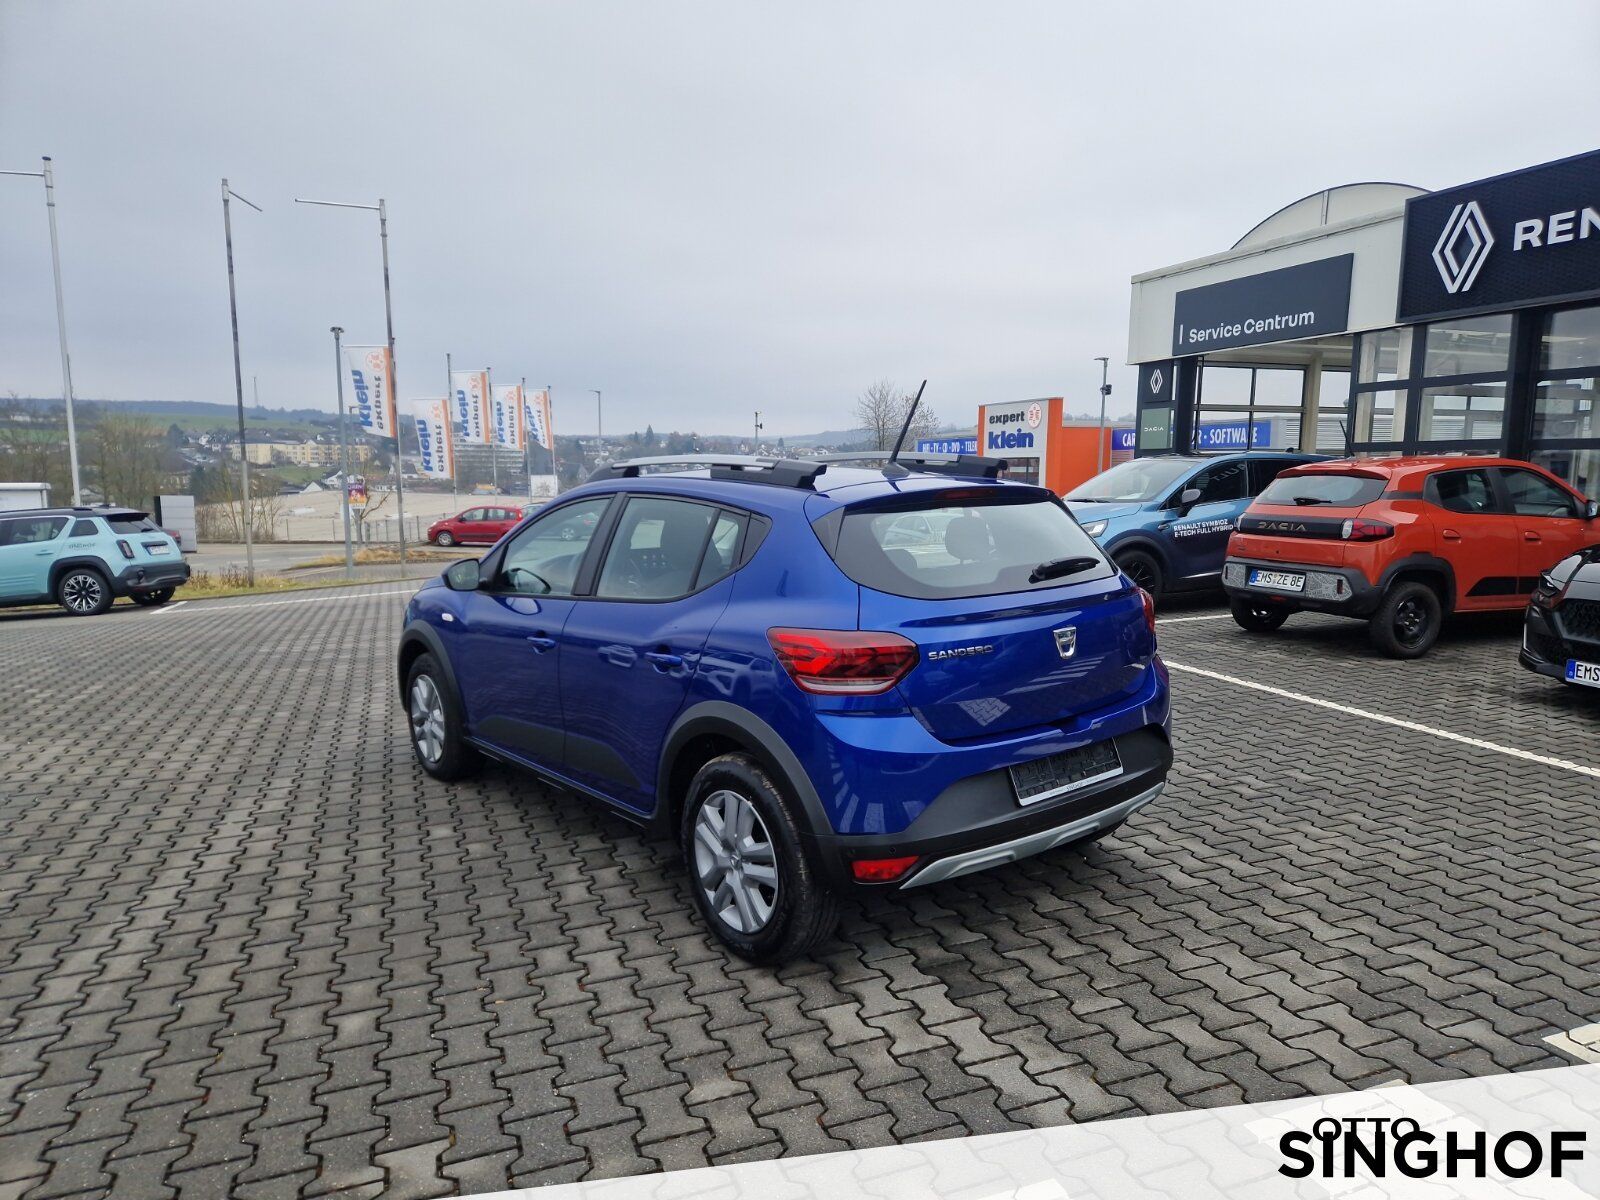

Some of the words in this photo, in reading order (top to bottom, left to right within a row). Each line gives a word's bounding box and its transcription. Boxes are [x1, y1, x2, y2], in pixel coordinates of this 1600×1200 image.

[1513, 207, 1600, 251] REN
[1189, 322, 1242, 344] Service
[1243, 311, 1316, 335] Centrum
[989, 410, 1025, 426] expert
[988, 428, 1034, 449] klein
[1209, 426, 1258, 444] SOFTWAE
[1173, 522, 1201, 532] RENAULT
[1202, 518, 1228, 528] SYMBIOZ
[1174, 529, 1196, 538] E-TECH
[1197, 527, 1212, 536] FULL
[1211, 524, 1234, 534] HYBRID
[1258, 521, 1307, 532] DACIA
[928, 644, 994, 660] SANDERO
[1575, 663, 1600, 682] EMS
